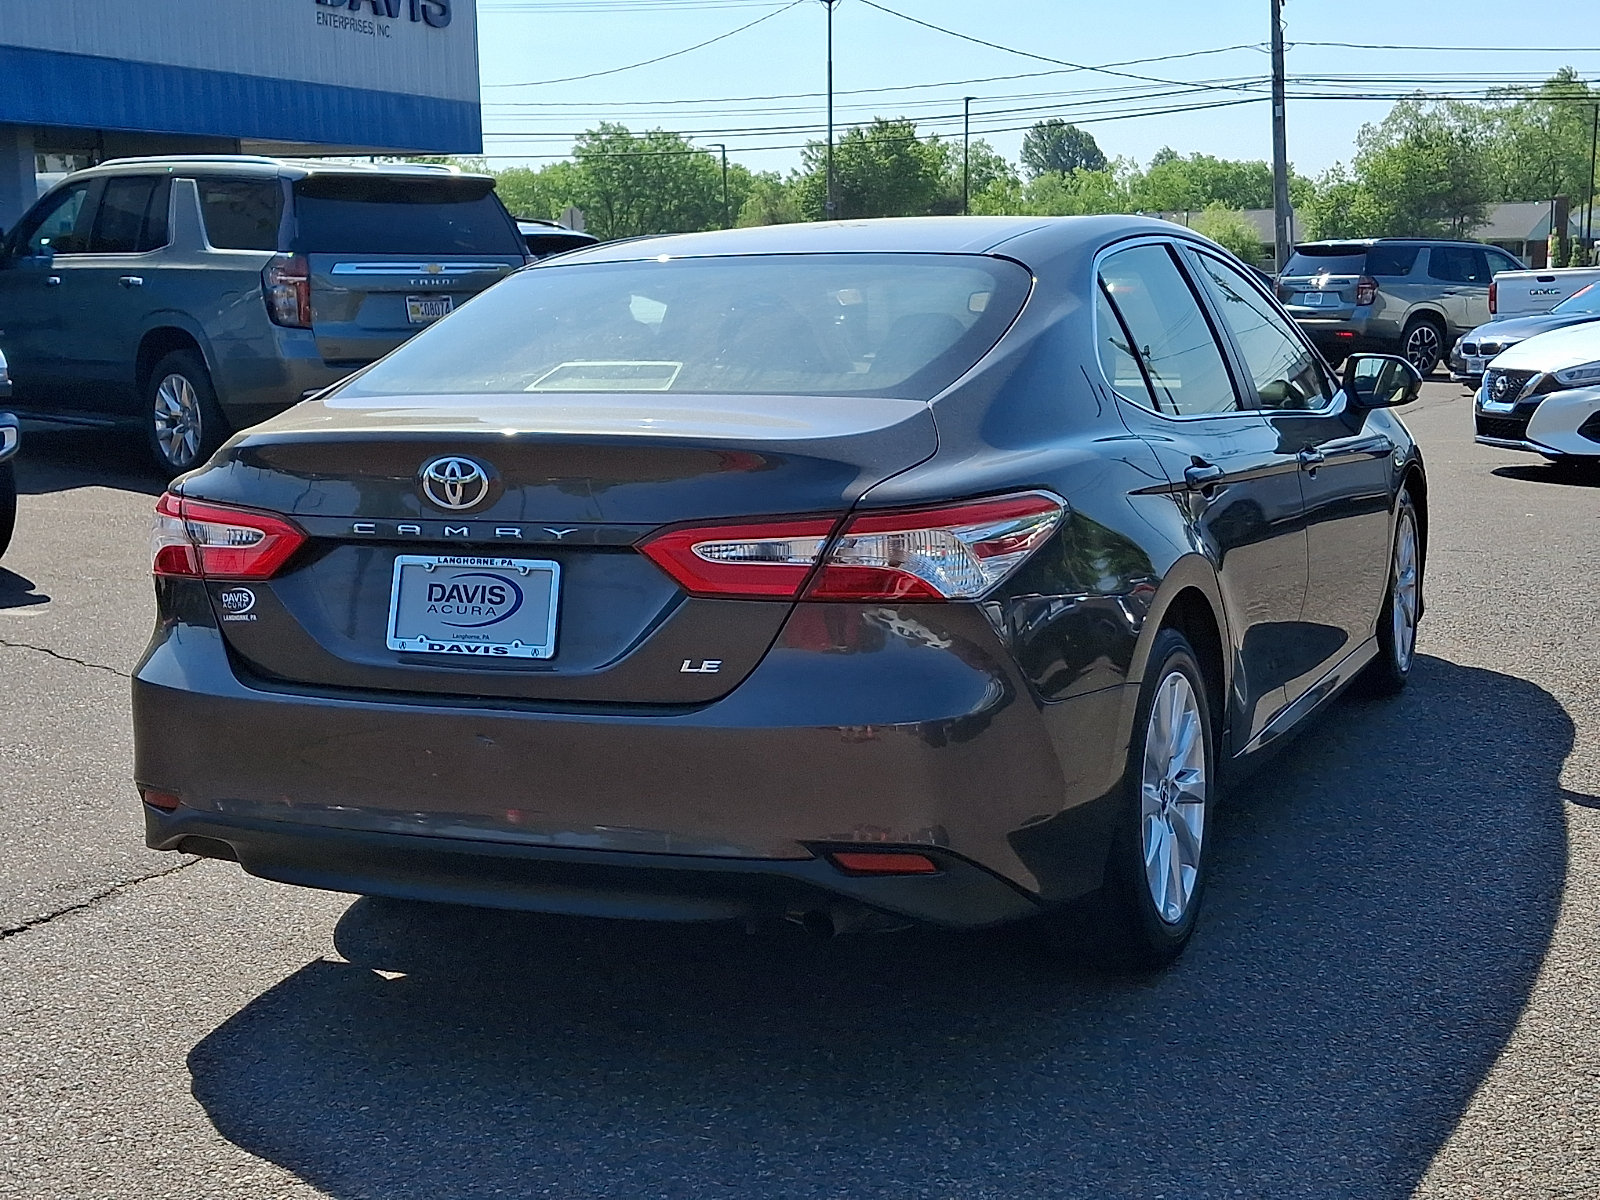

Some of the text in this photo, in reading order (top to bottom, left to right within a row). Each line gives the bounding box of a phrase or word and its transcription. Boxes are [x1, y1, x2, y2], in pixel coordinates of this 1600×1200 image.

[315, 0, 452, 28] VIS
[316, 11, 393, 38] ENTERPRISES, INC.
[1530, 288, 1560, 296] GMC
[353, 522, 579, 539] CAMRY
[222, 593, 249, 602] DAVIS
[427, 583, 506, 606] DAVIS
[427, 604, 497, 616] ACURA
[428, 643, 509, 655] DAVIS
[680, 659, 722, 673] LE
